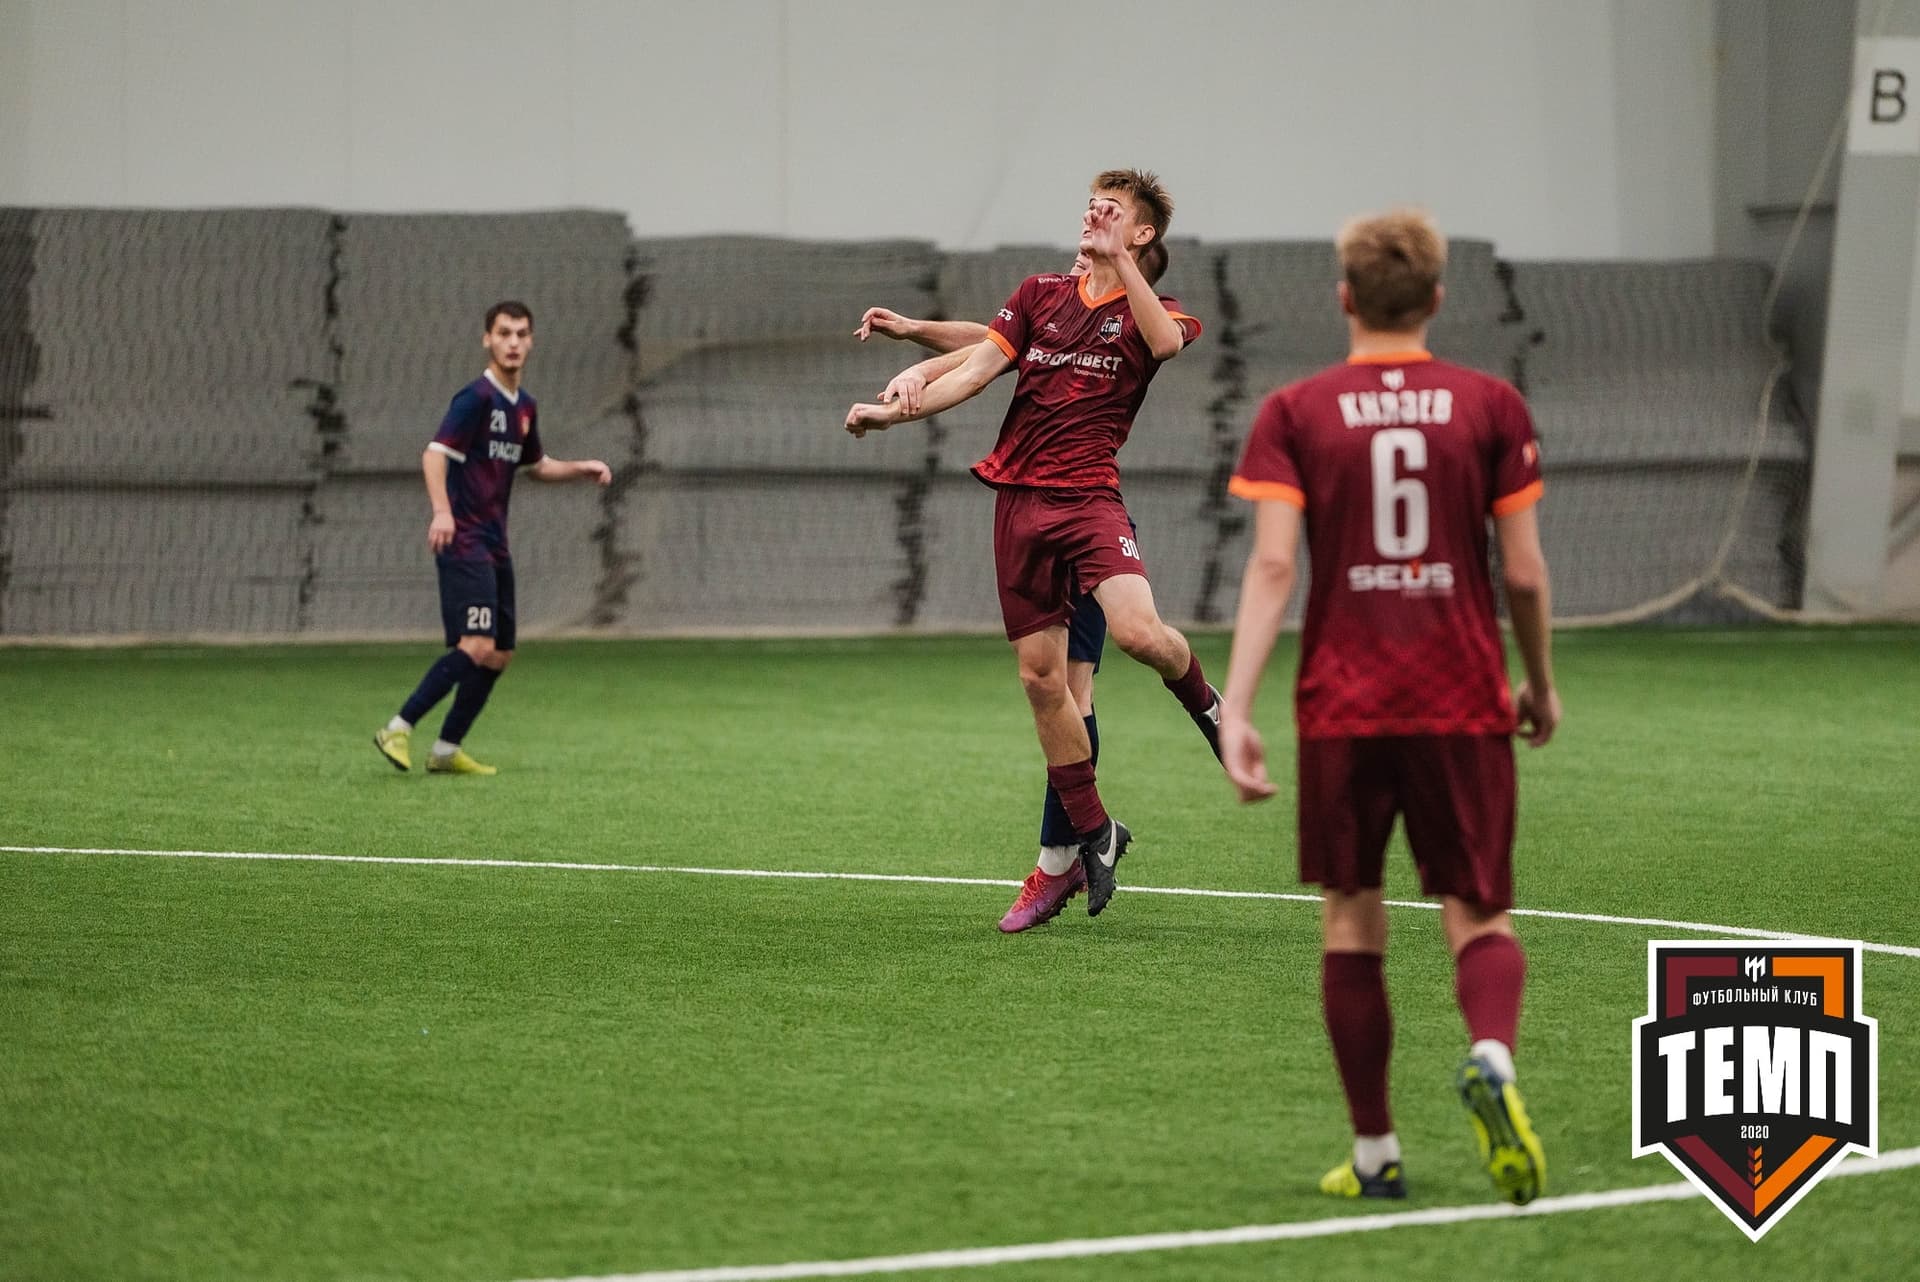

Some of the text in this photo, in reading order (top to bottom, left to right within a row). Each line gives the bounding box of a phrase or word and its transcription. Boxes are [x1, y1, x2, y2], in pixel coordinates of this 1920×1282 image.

[489, 408, 508, 433] 20
[1338, 388, 1454, 429] КНЯЗЕВ
[1370, 427, 1429, 561] 6
[1118, 535, 1140, 561] 30
[467, 605, 492, 630] 20
